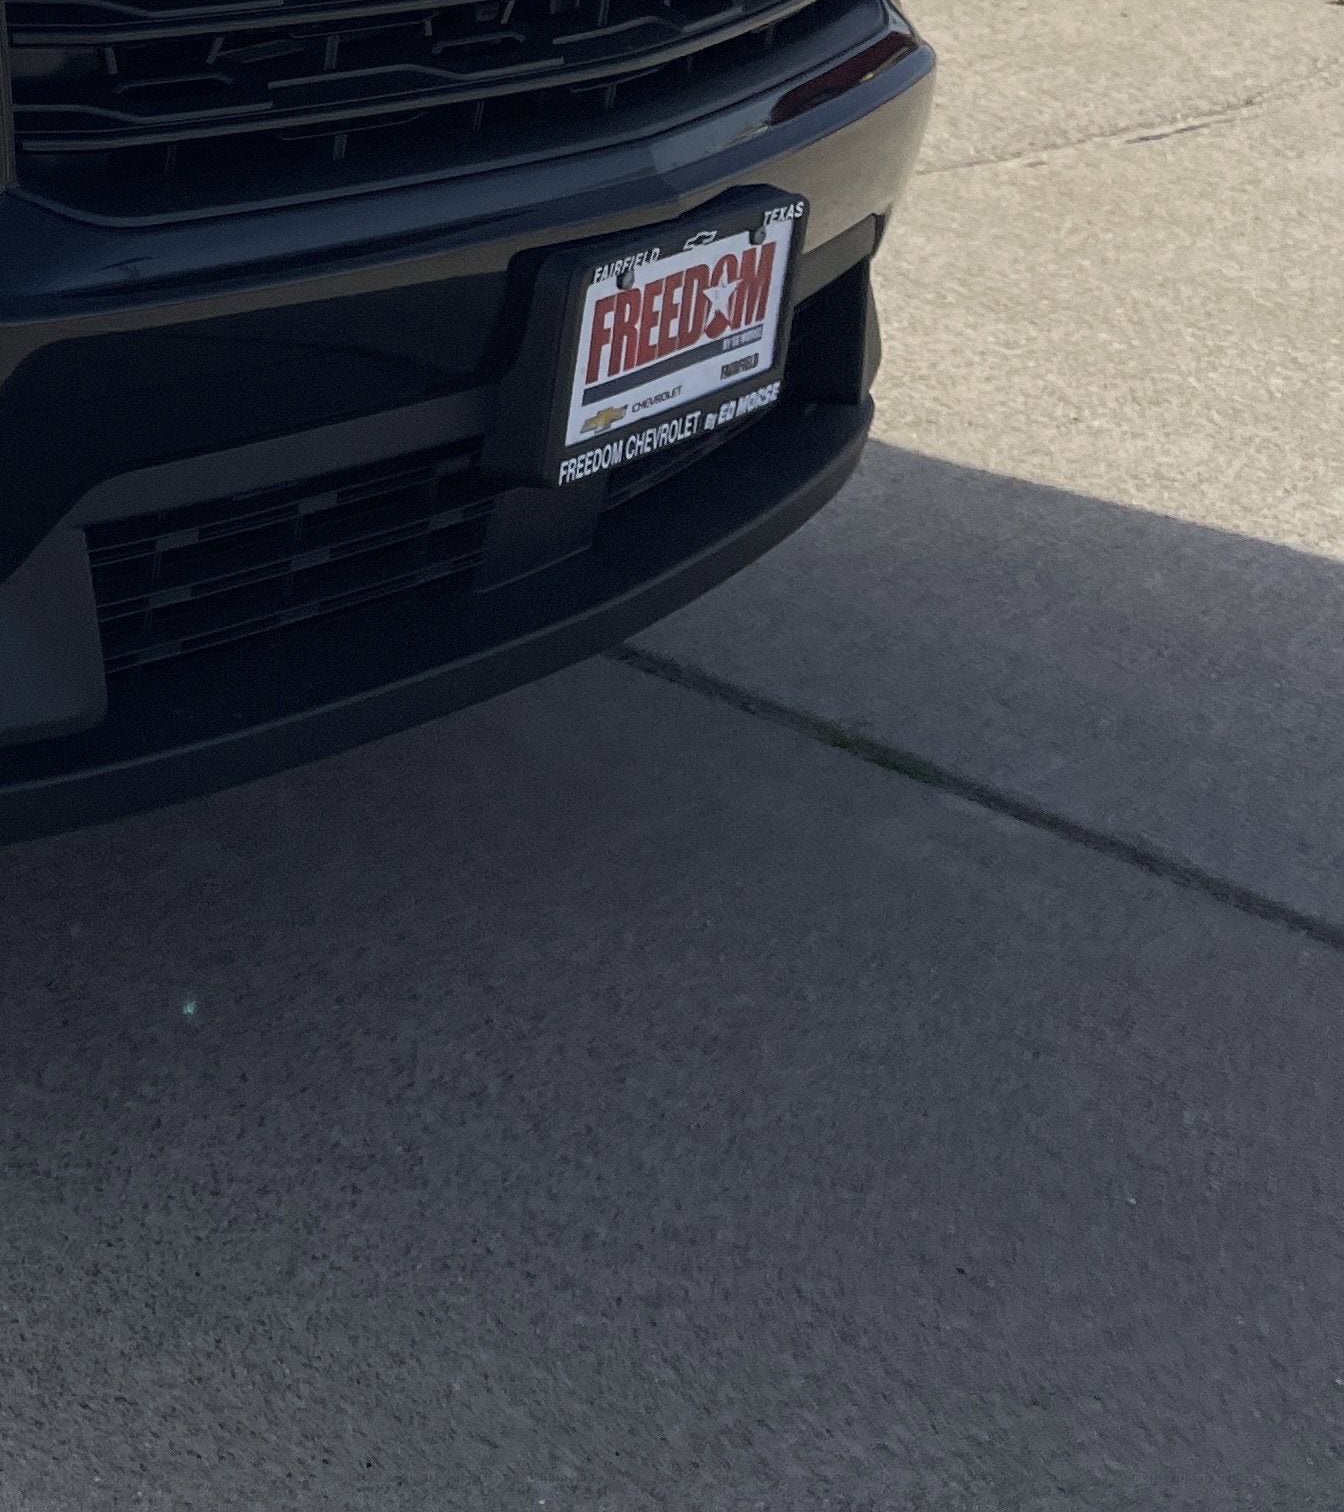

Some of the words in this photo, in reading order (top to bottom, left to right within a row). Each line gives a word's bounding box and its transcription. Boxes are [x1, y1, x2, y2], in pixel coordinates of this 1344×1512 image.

[764, 201, 805, 225] TEXAS
[593, 248, 661, 283] FAIRFIELD
[585, 241, 777, 385] FREEDOM
[631, 384, 683, 414] CHEVROLET
[558, 439, 623, 487] FREEDOM
[625, 410, 702, 460] CHEVROLET
[736, 381, 781, 417] MORSE
